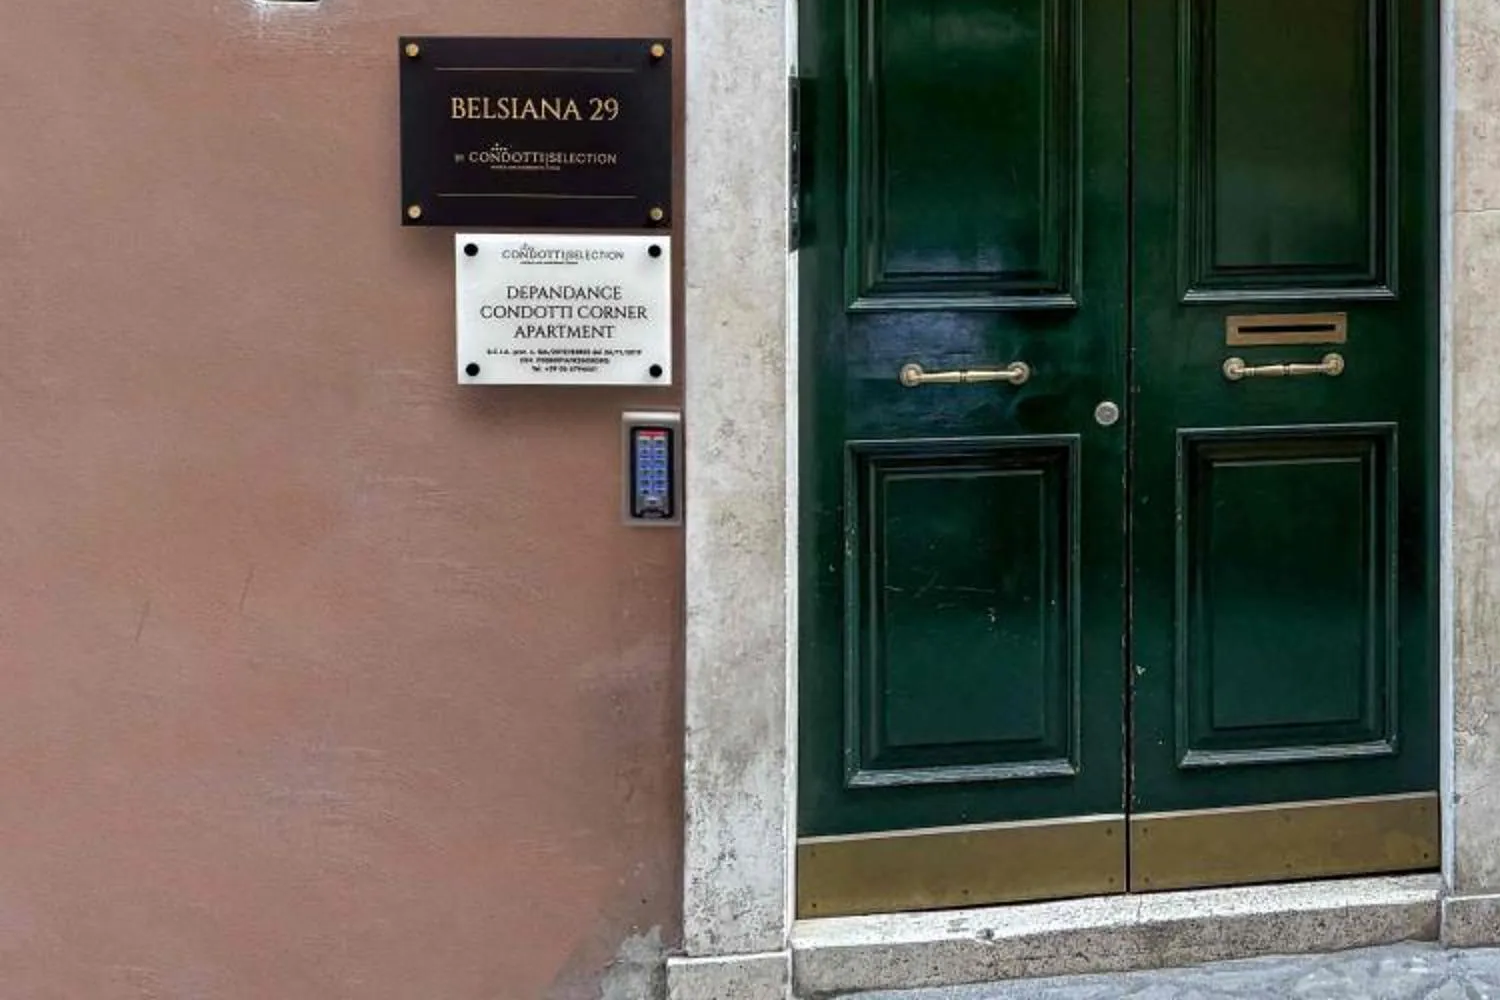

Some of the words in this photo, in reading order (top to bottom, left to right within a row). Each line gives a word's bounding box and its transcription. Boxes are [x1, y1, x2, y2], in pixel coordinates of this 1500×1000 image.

[451, 97, 582, 121] BELSIANA
[589, 98, 620, 121] 29
[506, 285, 622, 300] DEPANDANCE
[480, 305, 573, 319] CONDOTTI
[577, 305, 648, 319] CORNER
[514, 325, 616, 339] APARTMENT
